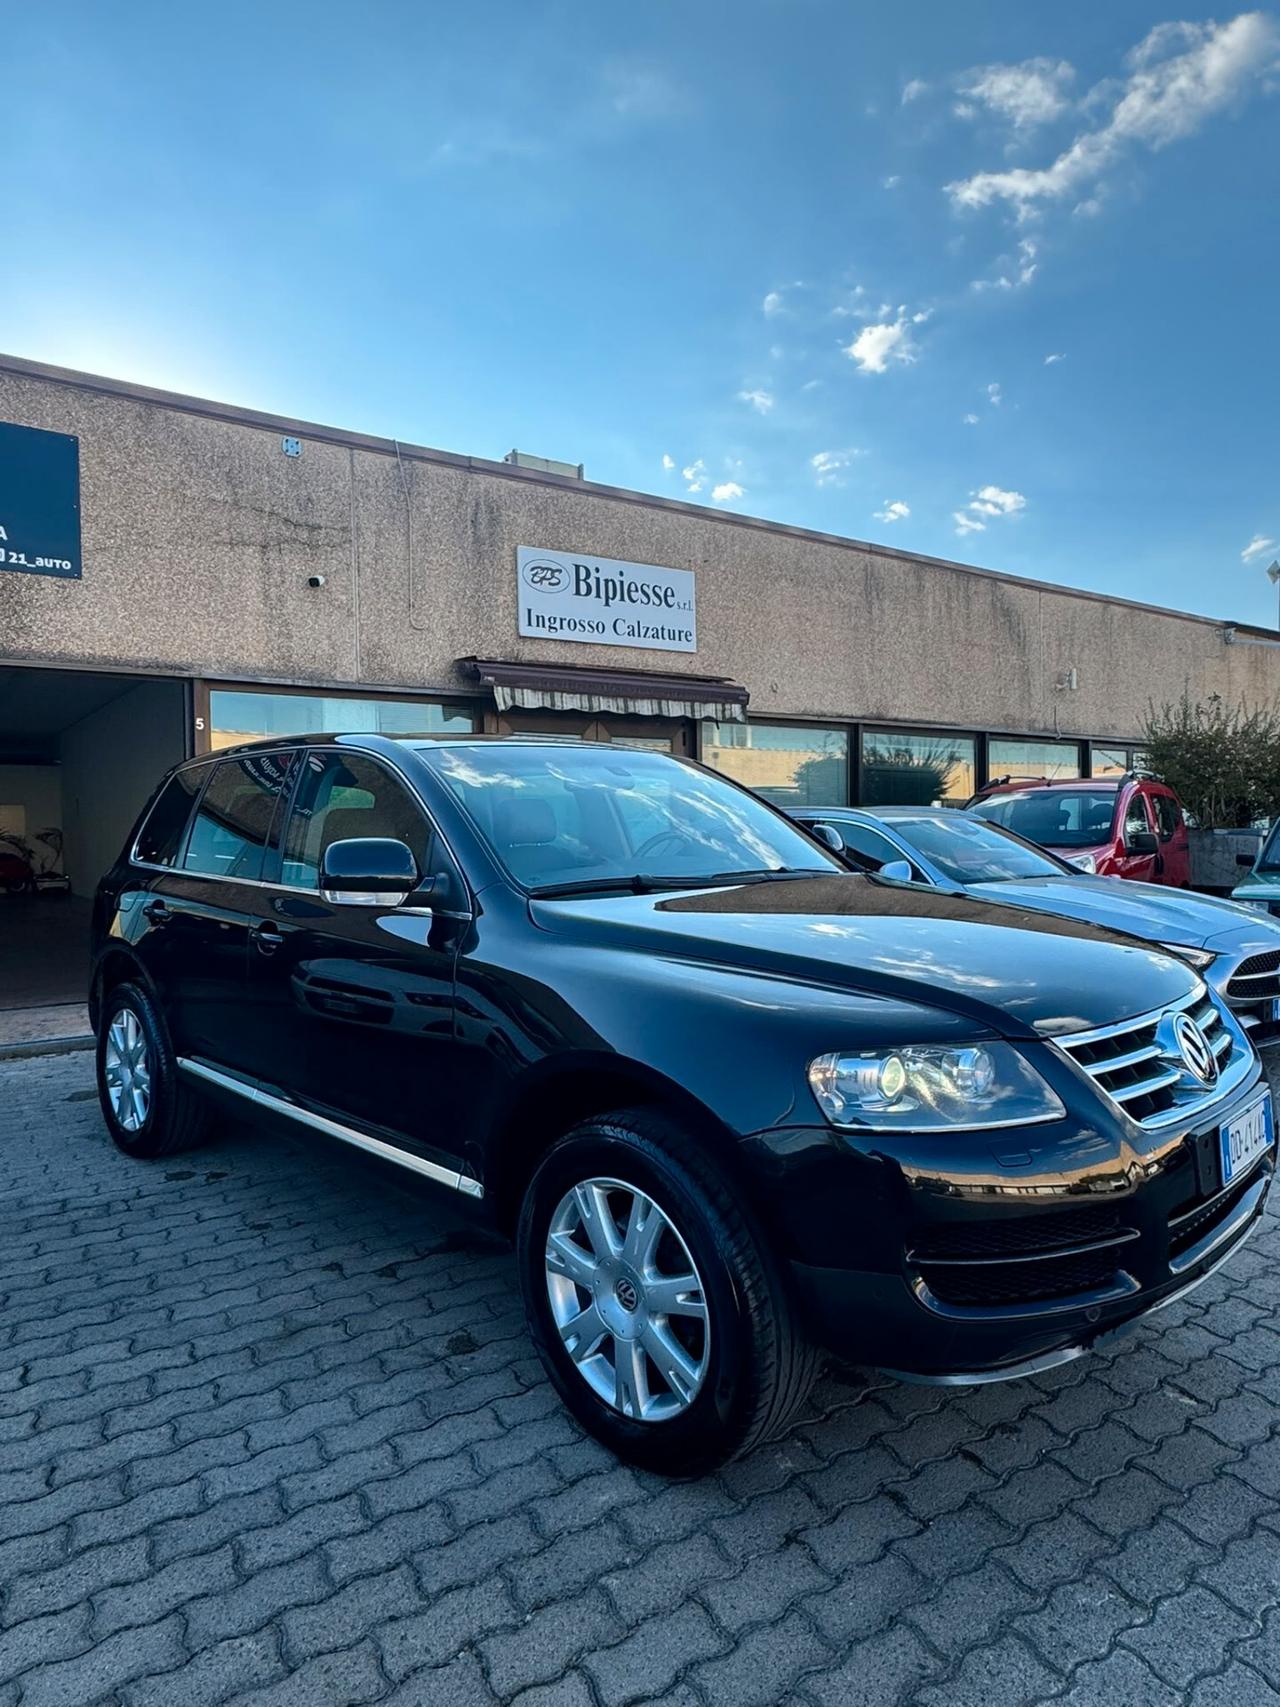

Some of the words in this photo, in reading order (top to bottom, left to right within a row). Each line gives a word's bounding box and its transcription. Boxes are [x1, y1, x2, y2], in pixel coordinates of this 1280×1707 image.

[572, 563, 675, 608] Bipiesse
[526, 608, 605, 634] Ingrosso
[612, 617, 693, 642] Calzature
[195, 717, 204, 730] 5
